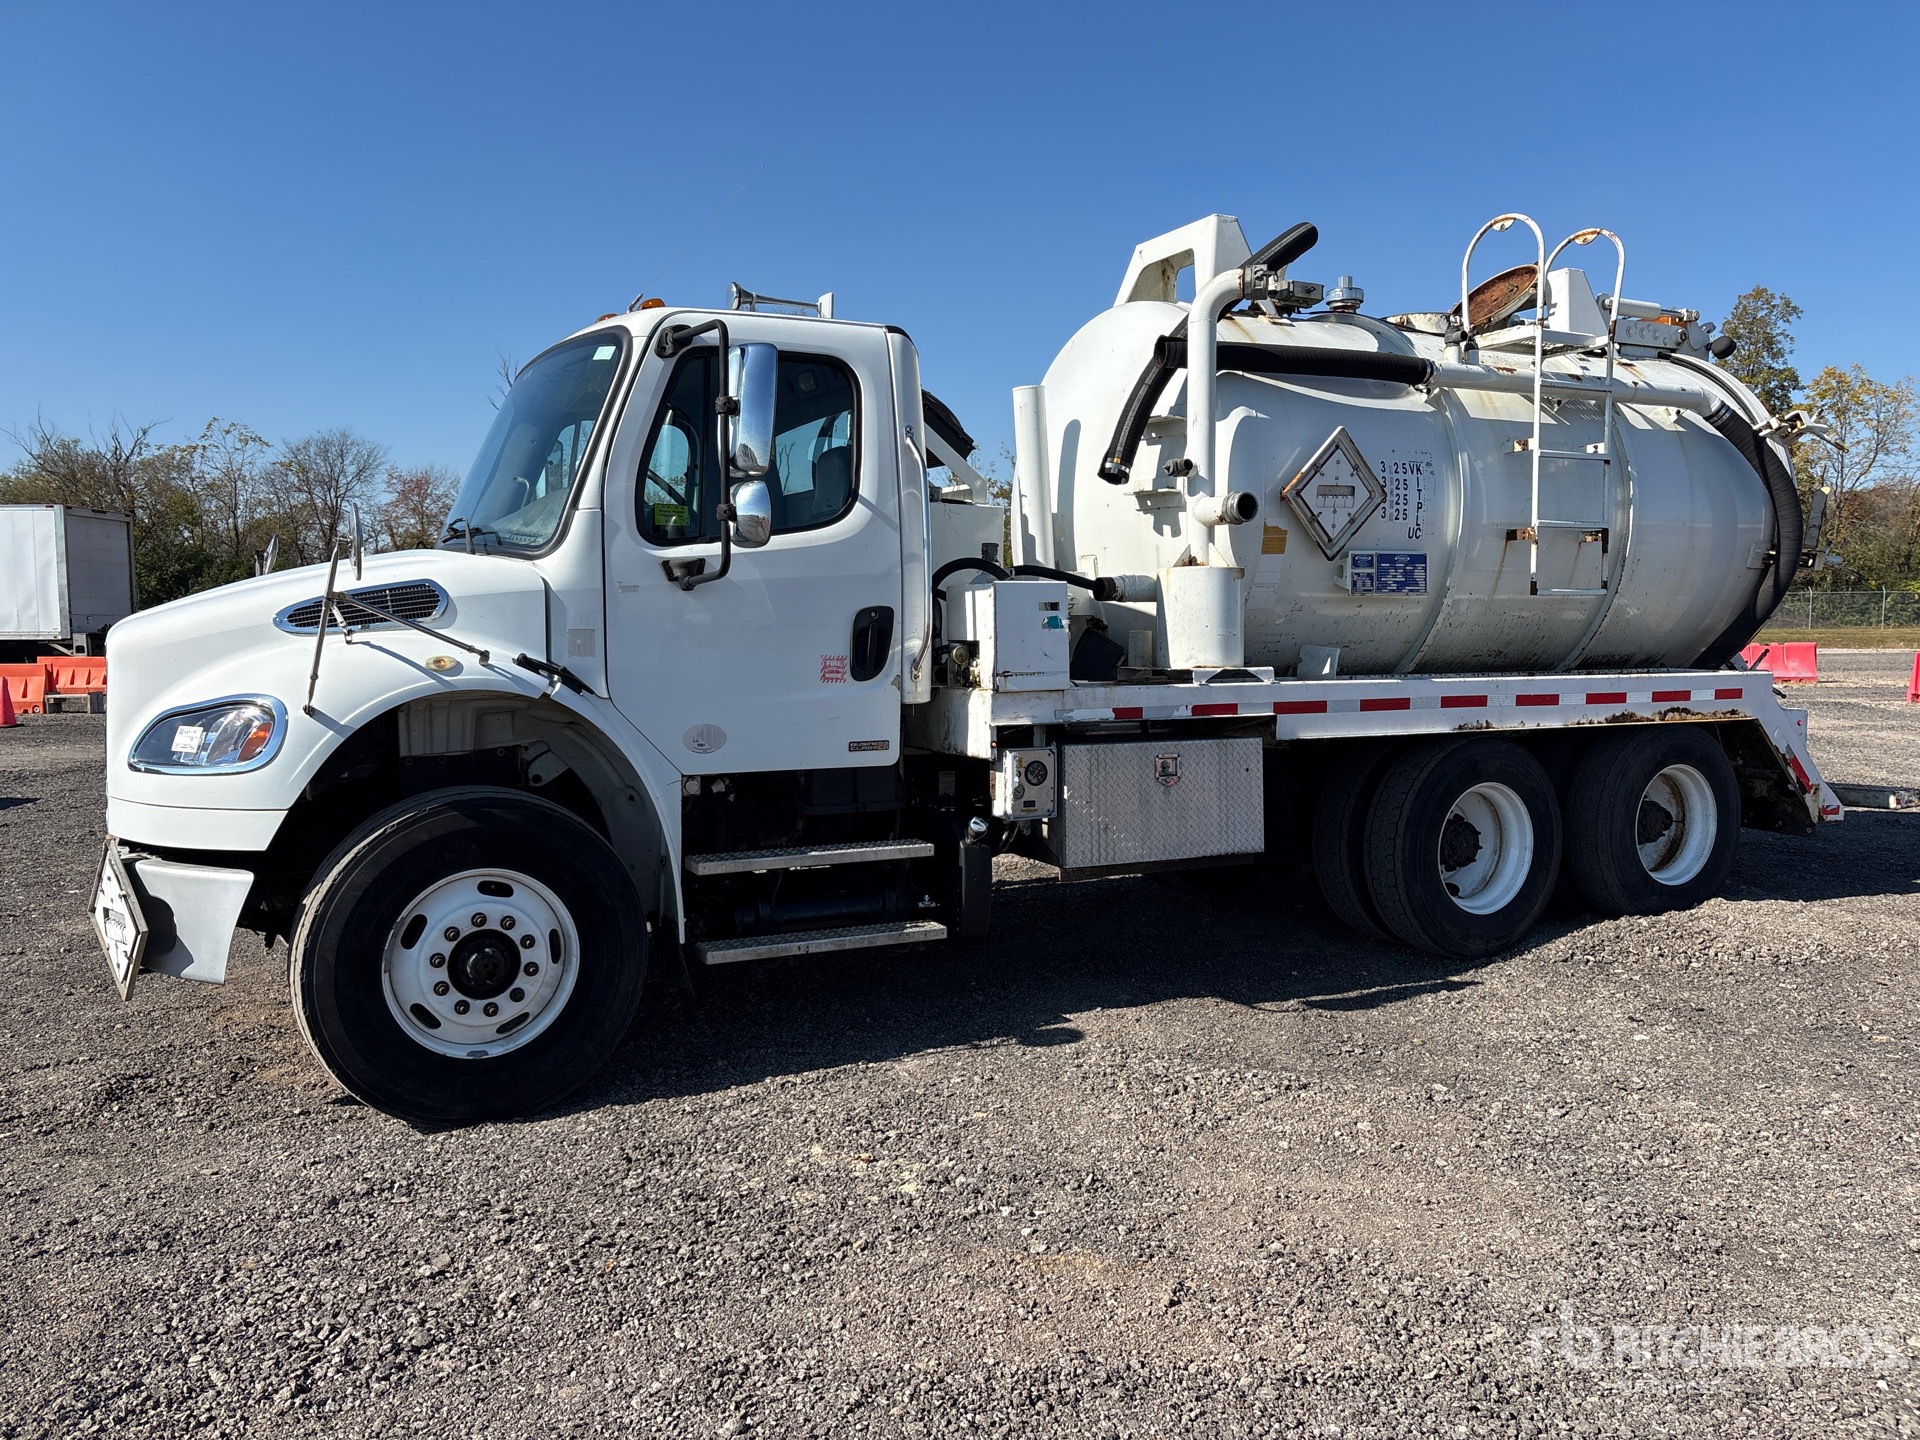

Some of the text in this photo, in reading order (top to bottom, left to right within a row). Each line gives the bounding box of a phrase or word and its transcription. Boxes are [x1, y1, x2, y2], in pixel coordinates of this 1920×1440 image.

[1380, 461, 1386, 473] 3
[1380, 507, 1387, 519] 3
[1408, 527, 1422, 540] UC
